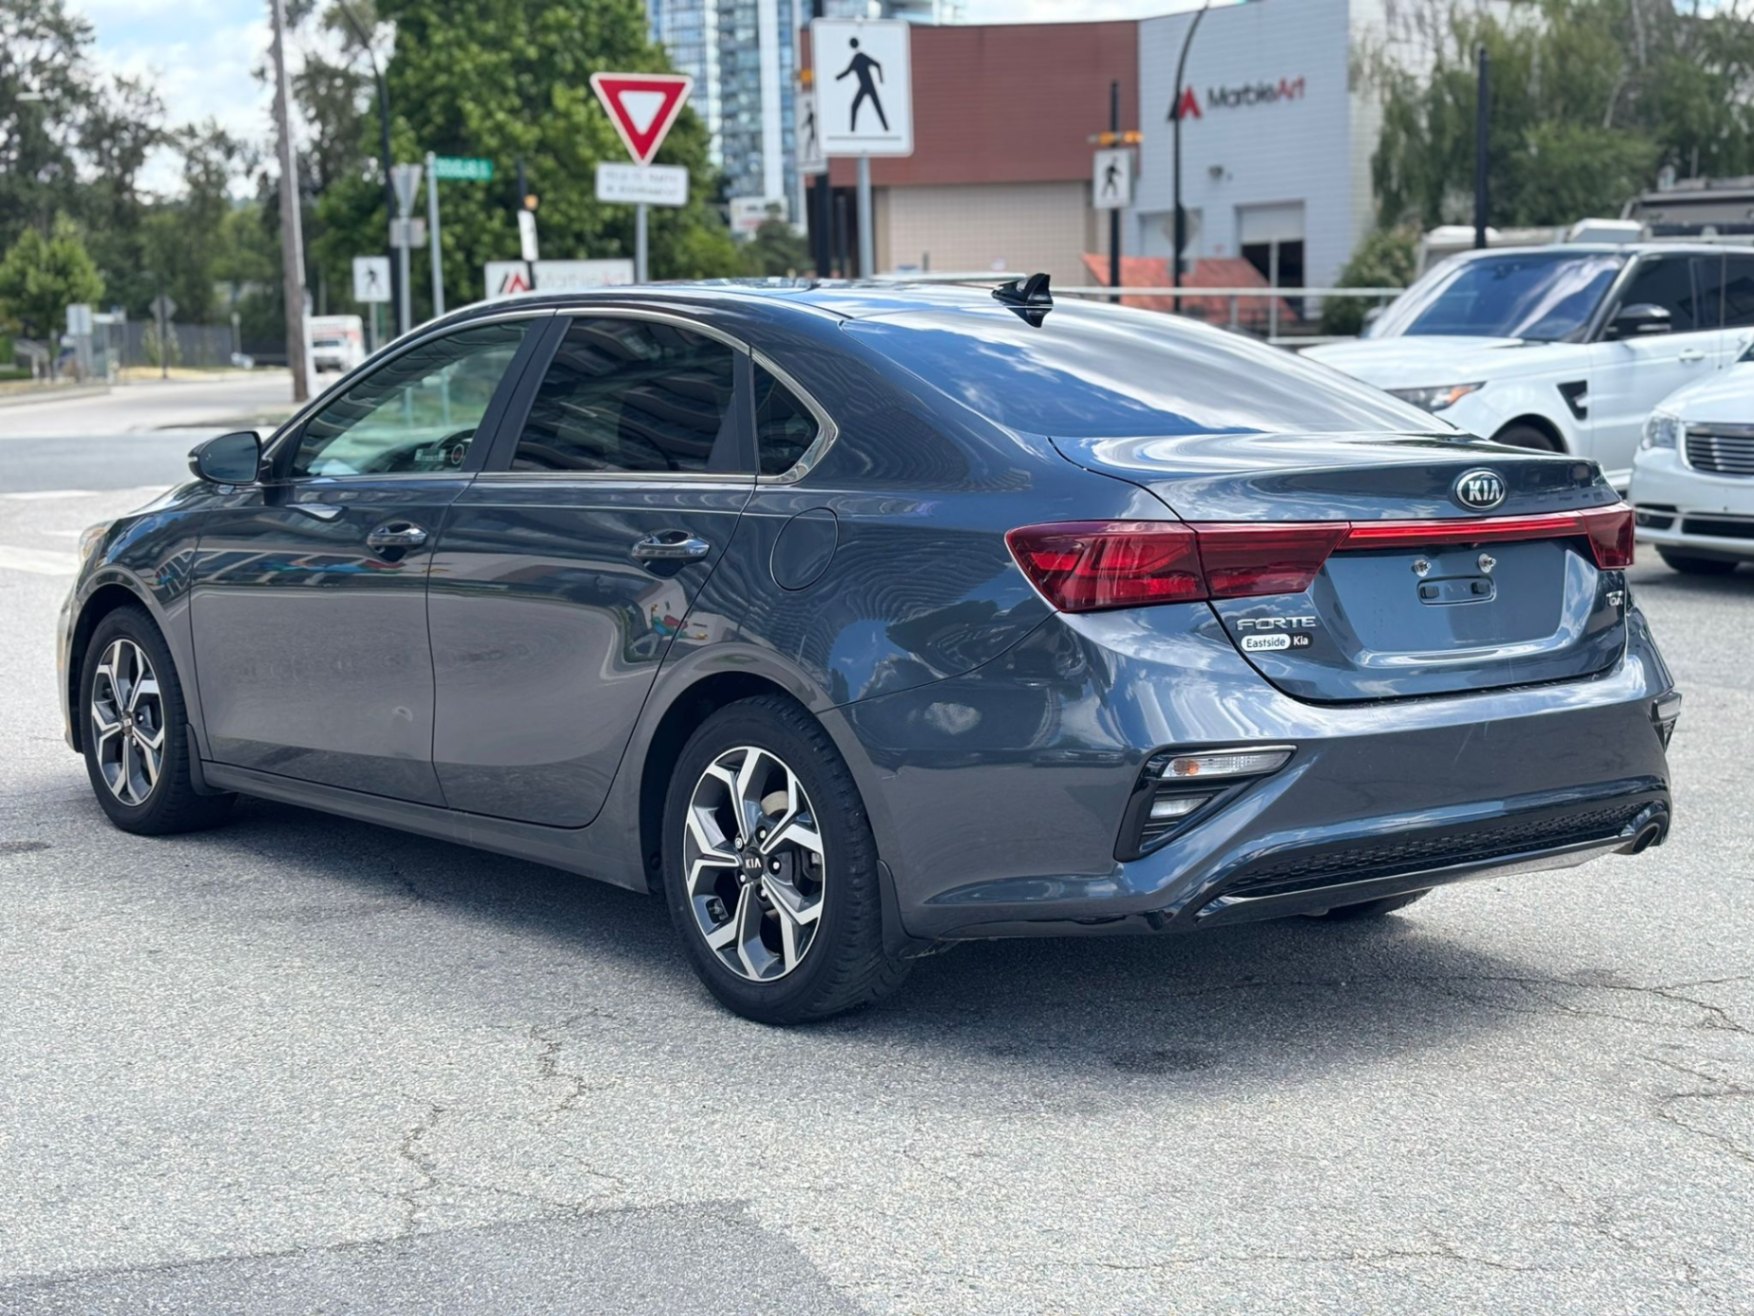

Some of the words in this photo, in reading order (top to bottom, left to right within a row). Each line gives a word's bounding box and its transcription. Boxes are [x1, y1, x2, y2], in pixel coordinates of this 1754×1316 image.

[1468, 479, 1500, 502] KIA
[1237, 616, 1317, 631] FORTE
[1246, 637, 1286, 648] Eastside
[1293, 635, 1309, 646] Kia
[745, 857, 762, 869] KIA
